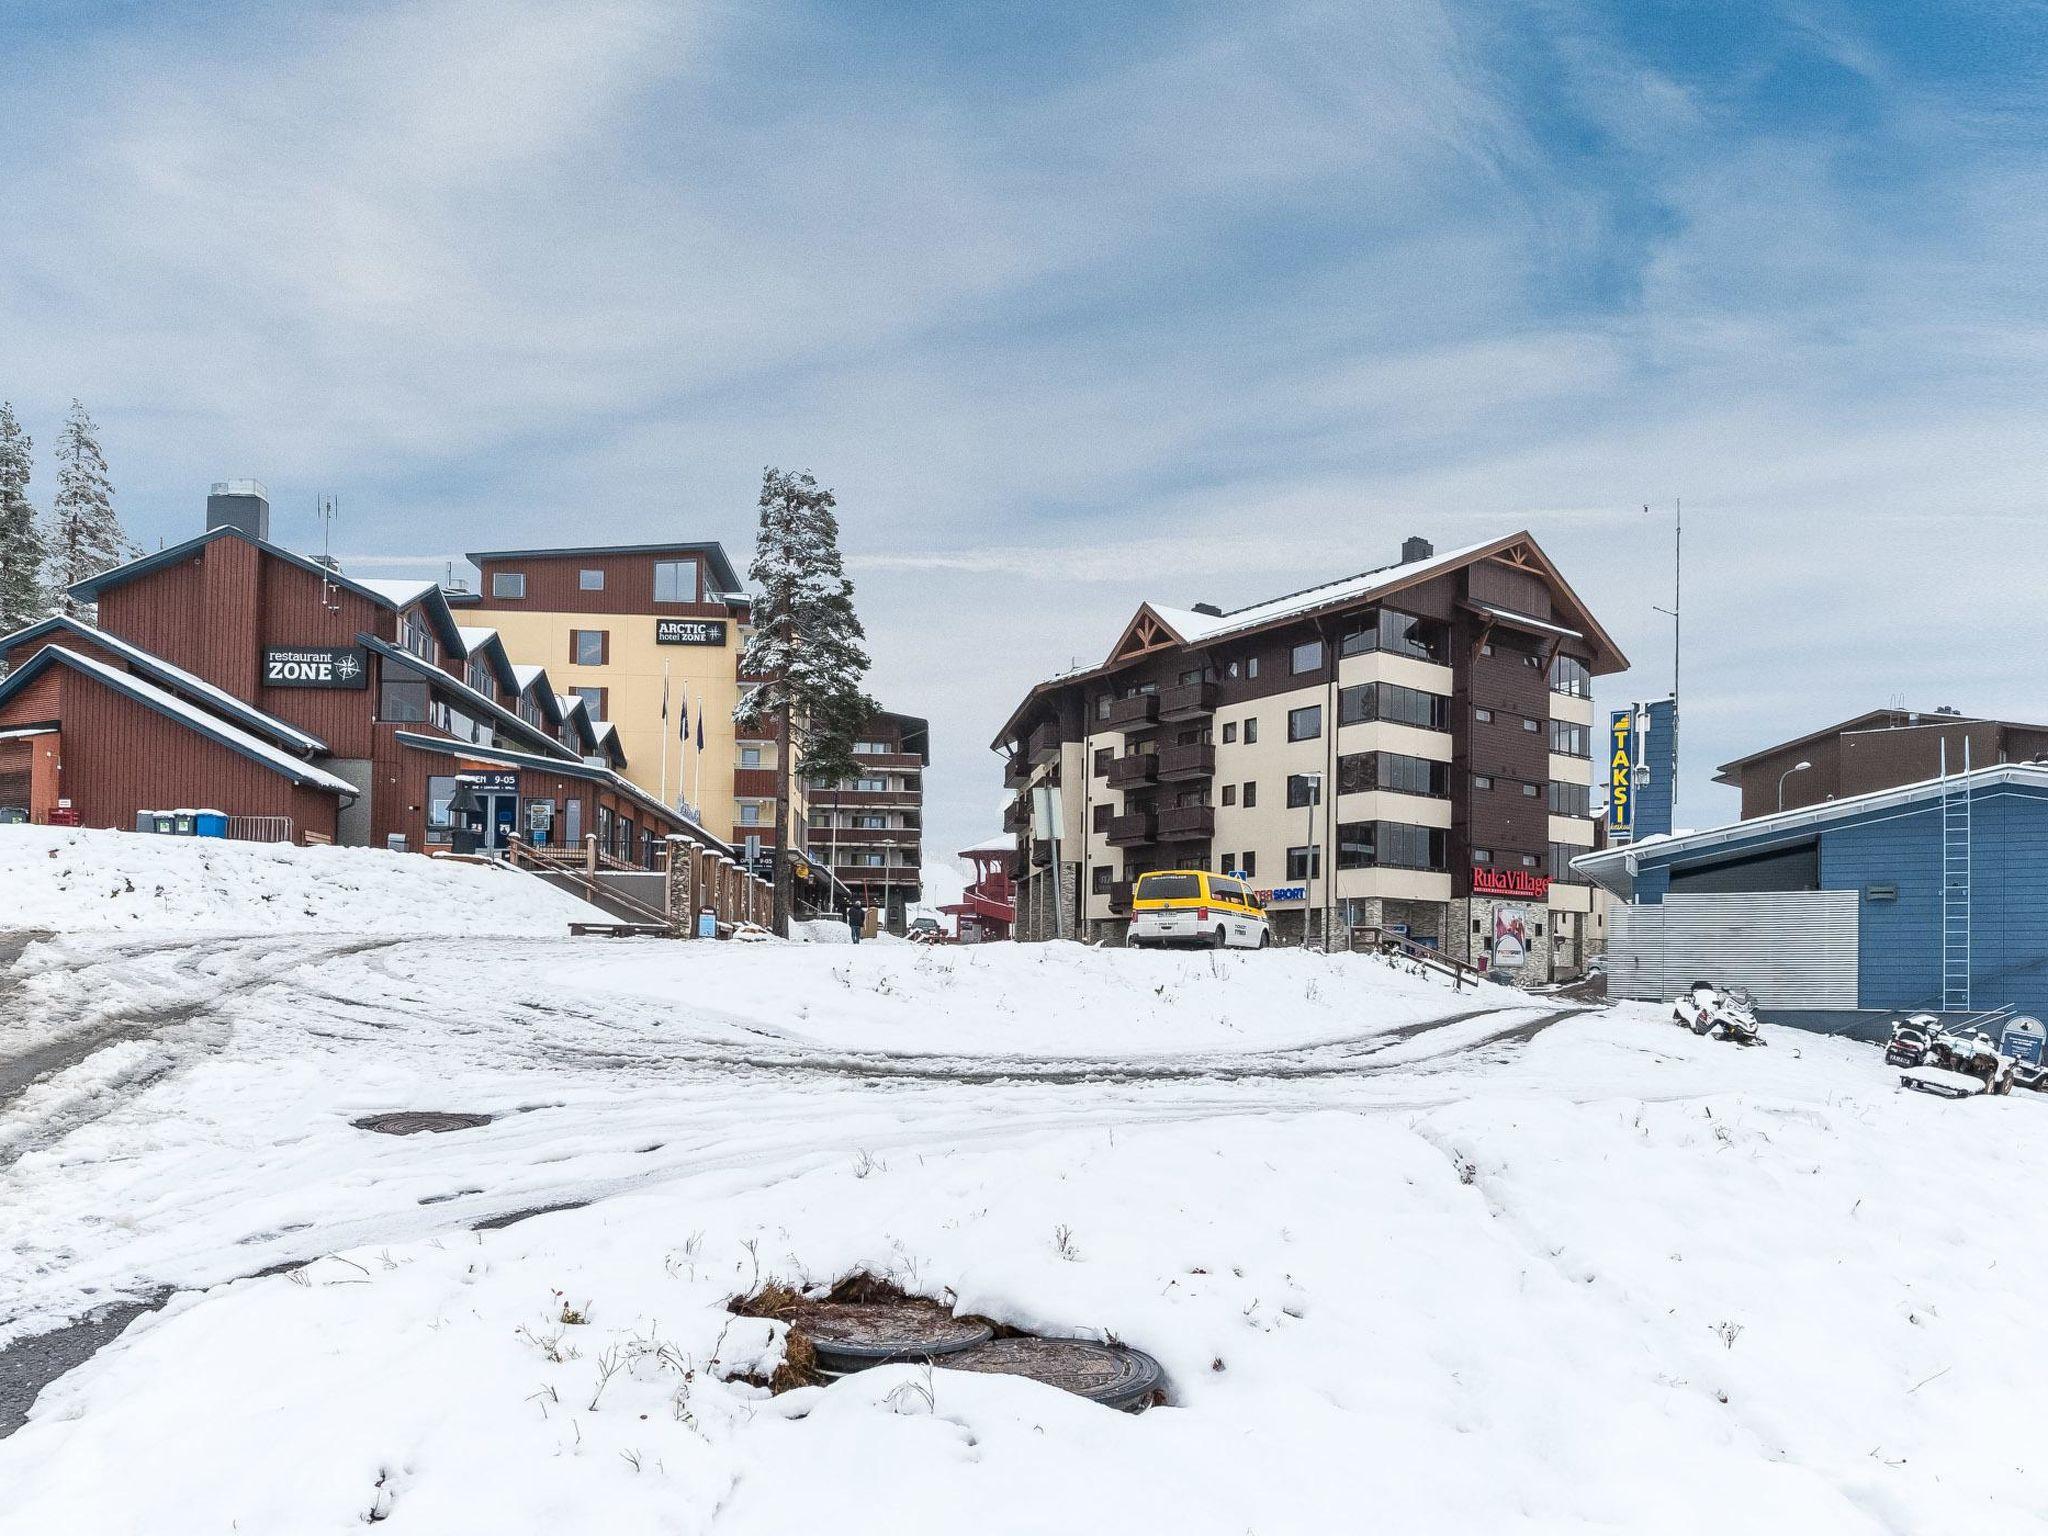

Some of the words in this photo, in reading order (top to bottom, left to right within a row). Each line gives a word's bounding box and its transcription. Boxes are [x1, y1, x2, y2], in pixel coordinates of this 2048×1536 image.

[659, 623, 706, 634] ARCTIC
[659, 633, 680, 641] hotel
[682, 634, 707, 642] ZONE
[269, 652, 333, 663] restaurant
[269, 662, 332, 680] ZONE
[495, 775, 515, 784] 9-05
[1612, 731, 1630, 823] TAKSI
